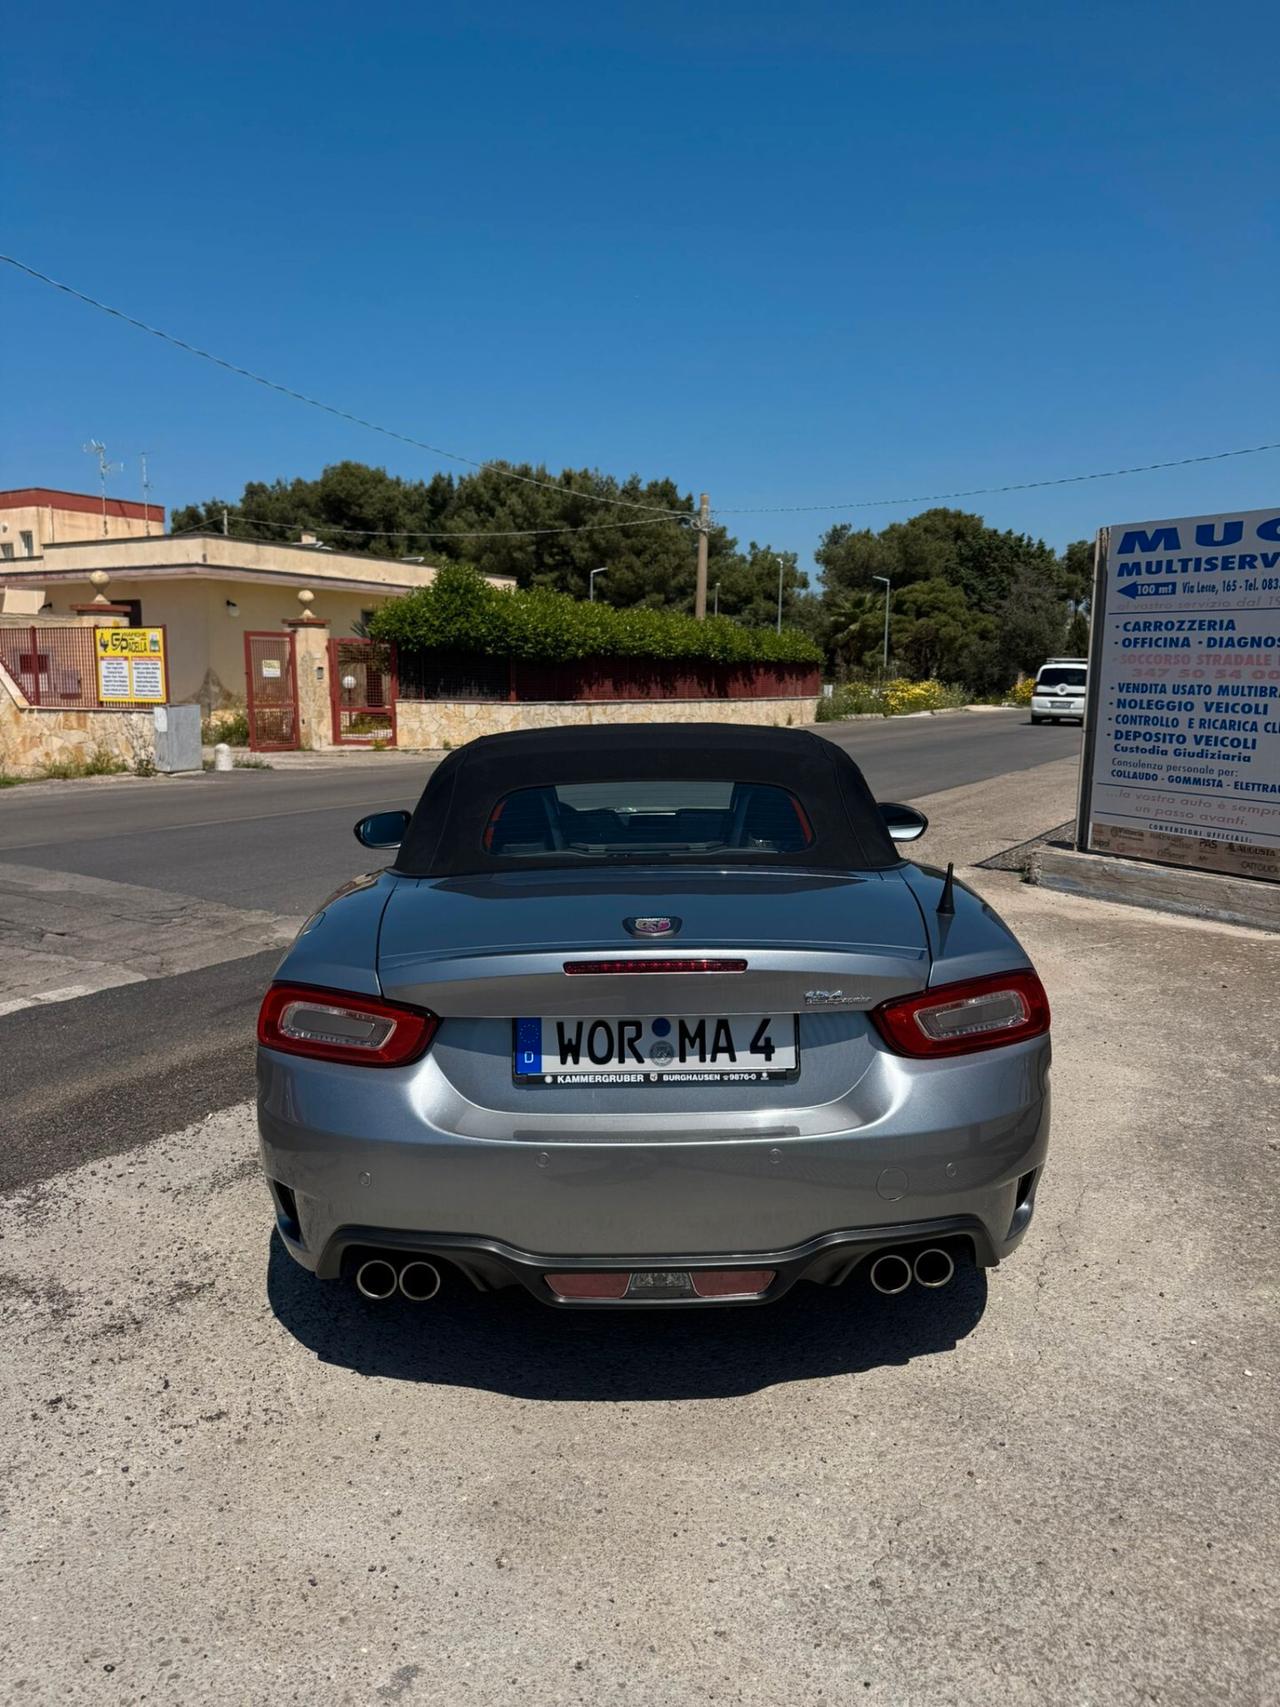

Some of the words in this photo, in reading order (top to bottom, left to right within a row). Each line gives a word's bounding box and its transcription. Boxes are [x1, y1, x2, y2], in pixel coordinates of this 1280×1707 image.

[1117, 552, 1280, 577] MULTISERV
[1137, 584, 1155, 595] 100
[1182, 581, 1195, 594] Via
[1222, 580, 1237, 592] 165
[1244, 578, 1259, 591] Tel.
[1262, 577, 1280, 590] 083
[1179, 598, 1231, 609] servizio
[1236, 597, 1261, 607] dal
[1123, 619, 1236, 632] CARROZZERIA
[1121, 636, 1191, 649] OFFICINA
[1119, 653, 1191, 666] SOCCORSO
[1196, 653, 1272, 667] STRADALE
[1131, 668, 1170, 678] 347
[1118, 682, 1167, 695] VENDITA
[1172, 684, 1212, 696] USATO
[1217, 685, 1280, 698] MULTIBR
[1116, 698, 1194, 713] NOLEGGIO
[1204, 701, 1269, 716] VEICOLI
[1115, 714, 1180, 729] CONTROLLO
[1187, 718, 1195, 729] E
[1199, 718, 1259, 733] RICARICA
[1114, 730, 1187, 745] DEPOSITO
[1193, 734, 1257, 750] VEICOLI
[1113, 743, 1168, 756] Custodia
[1173, 748, 1252, 763] Giudiziaria
[1166, 763, 1215, 777] personale
[1111, 769, 1158, 782] COLLAUDO
[1167, 775, 1224, 789] GOMMISTA
[1135, 793, 1176, 804] vostra
[1180, 796, 1212, 809] auto
[1135, 805, 1151, 814] un
[1154, 807, 1194, 821] passo
[1199, 812, 1249, 827] avanti.
[556, 1019, 645, 1066] WOR
[678, 1018, 737, 1063] MA
[749, 1018, 775, 1062] 4
[524, 1051, 534, 1064] D
[557, 1074, 645, 1084] KAMMERGRUBER
[663, 1074, 720, 1082] BURGHAUSEN
